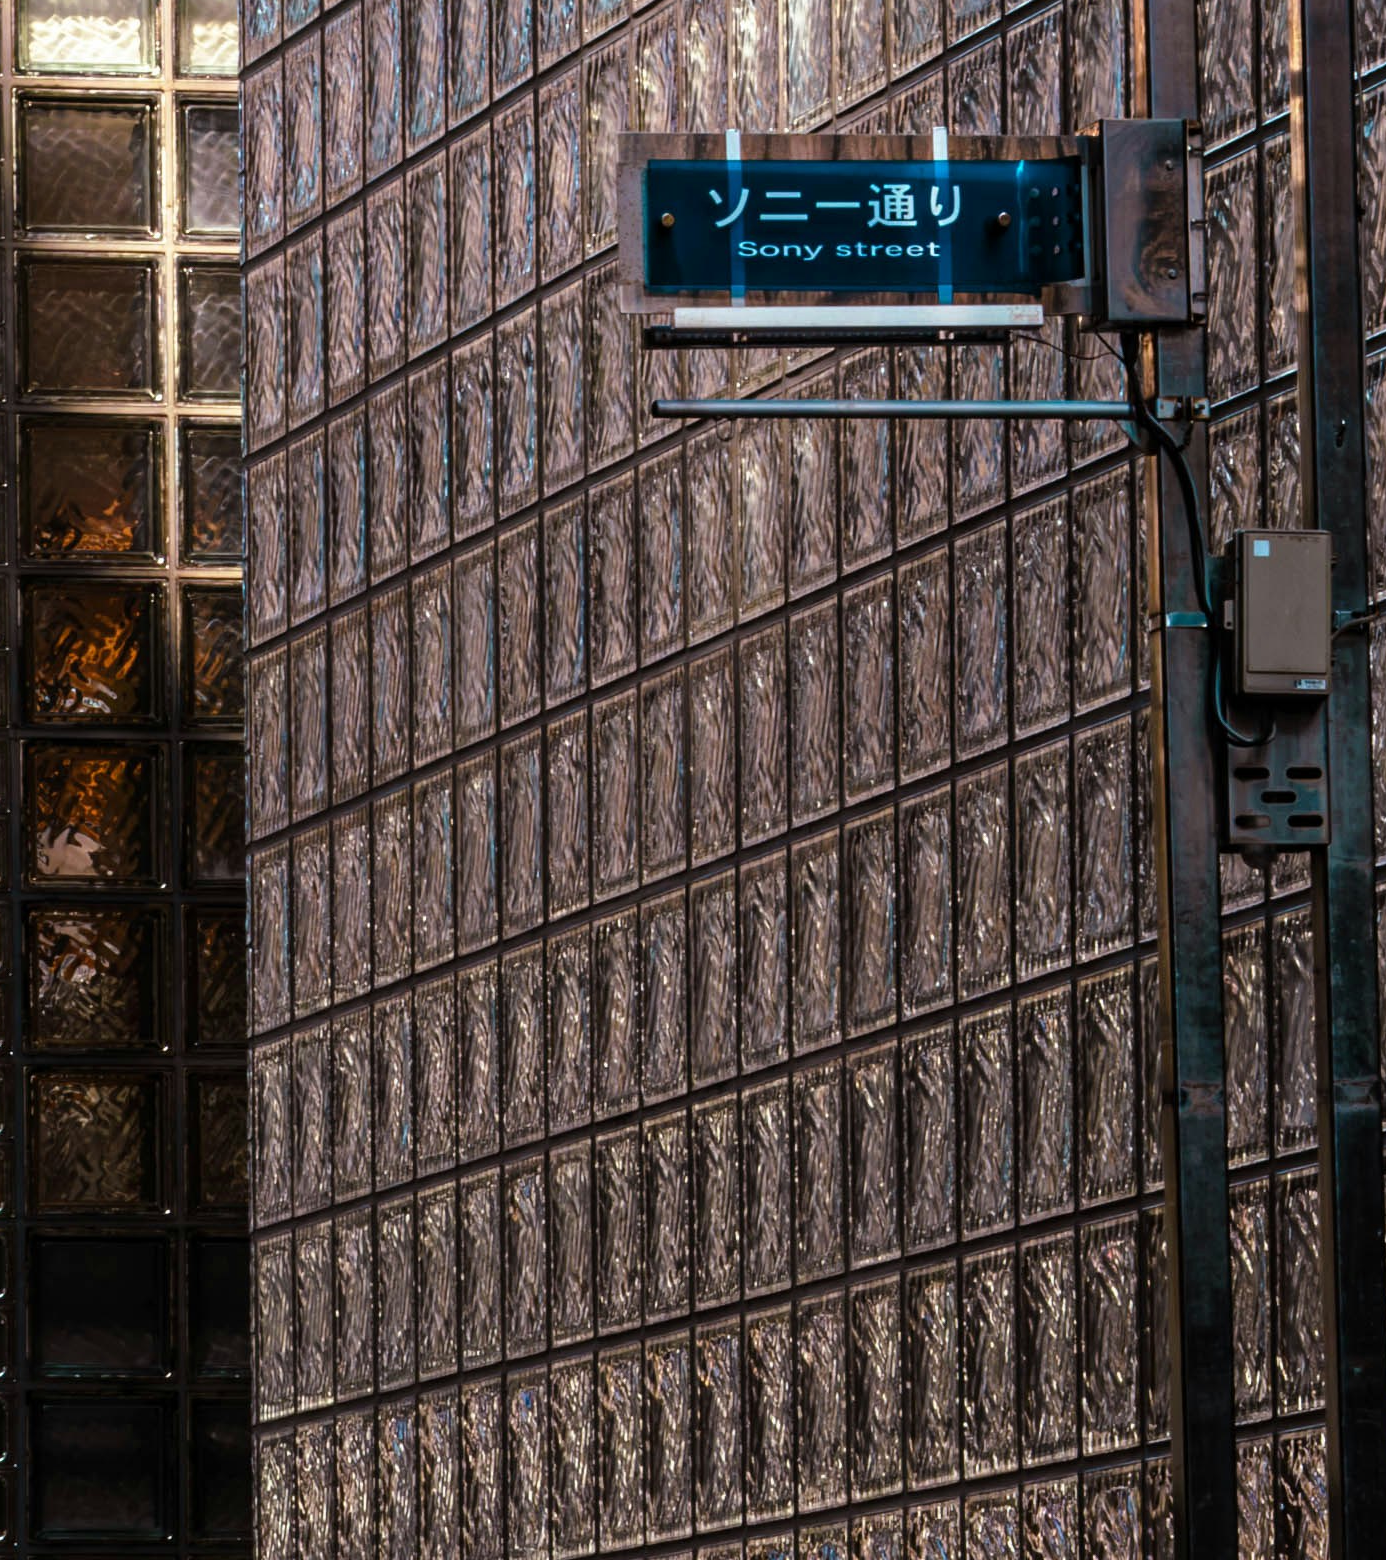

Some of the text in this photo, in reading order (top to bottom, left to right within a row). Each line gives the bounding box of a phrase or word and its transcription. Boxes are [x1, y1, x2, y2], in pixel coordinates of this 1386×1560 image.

[709, 183, 962, 228] ソニー通り
[737, 240, 941, 261] Sony street
